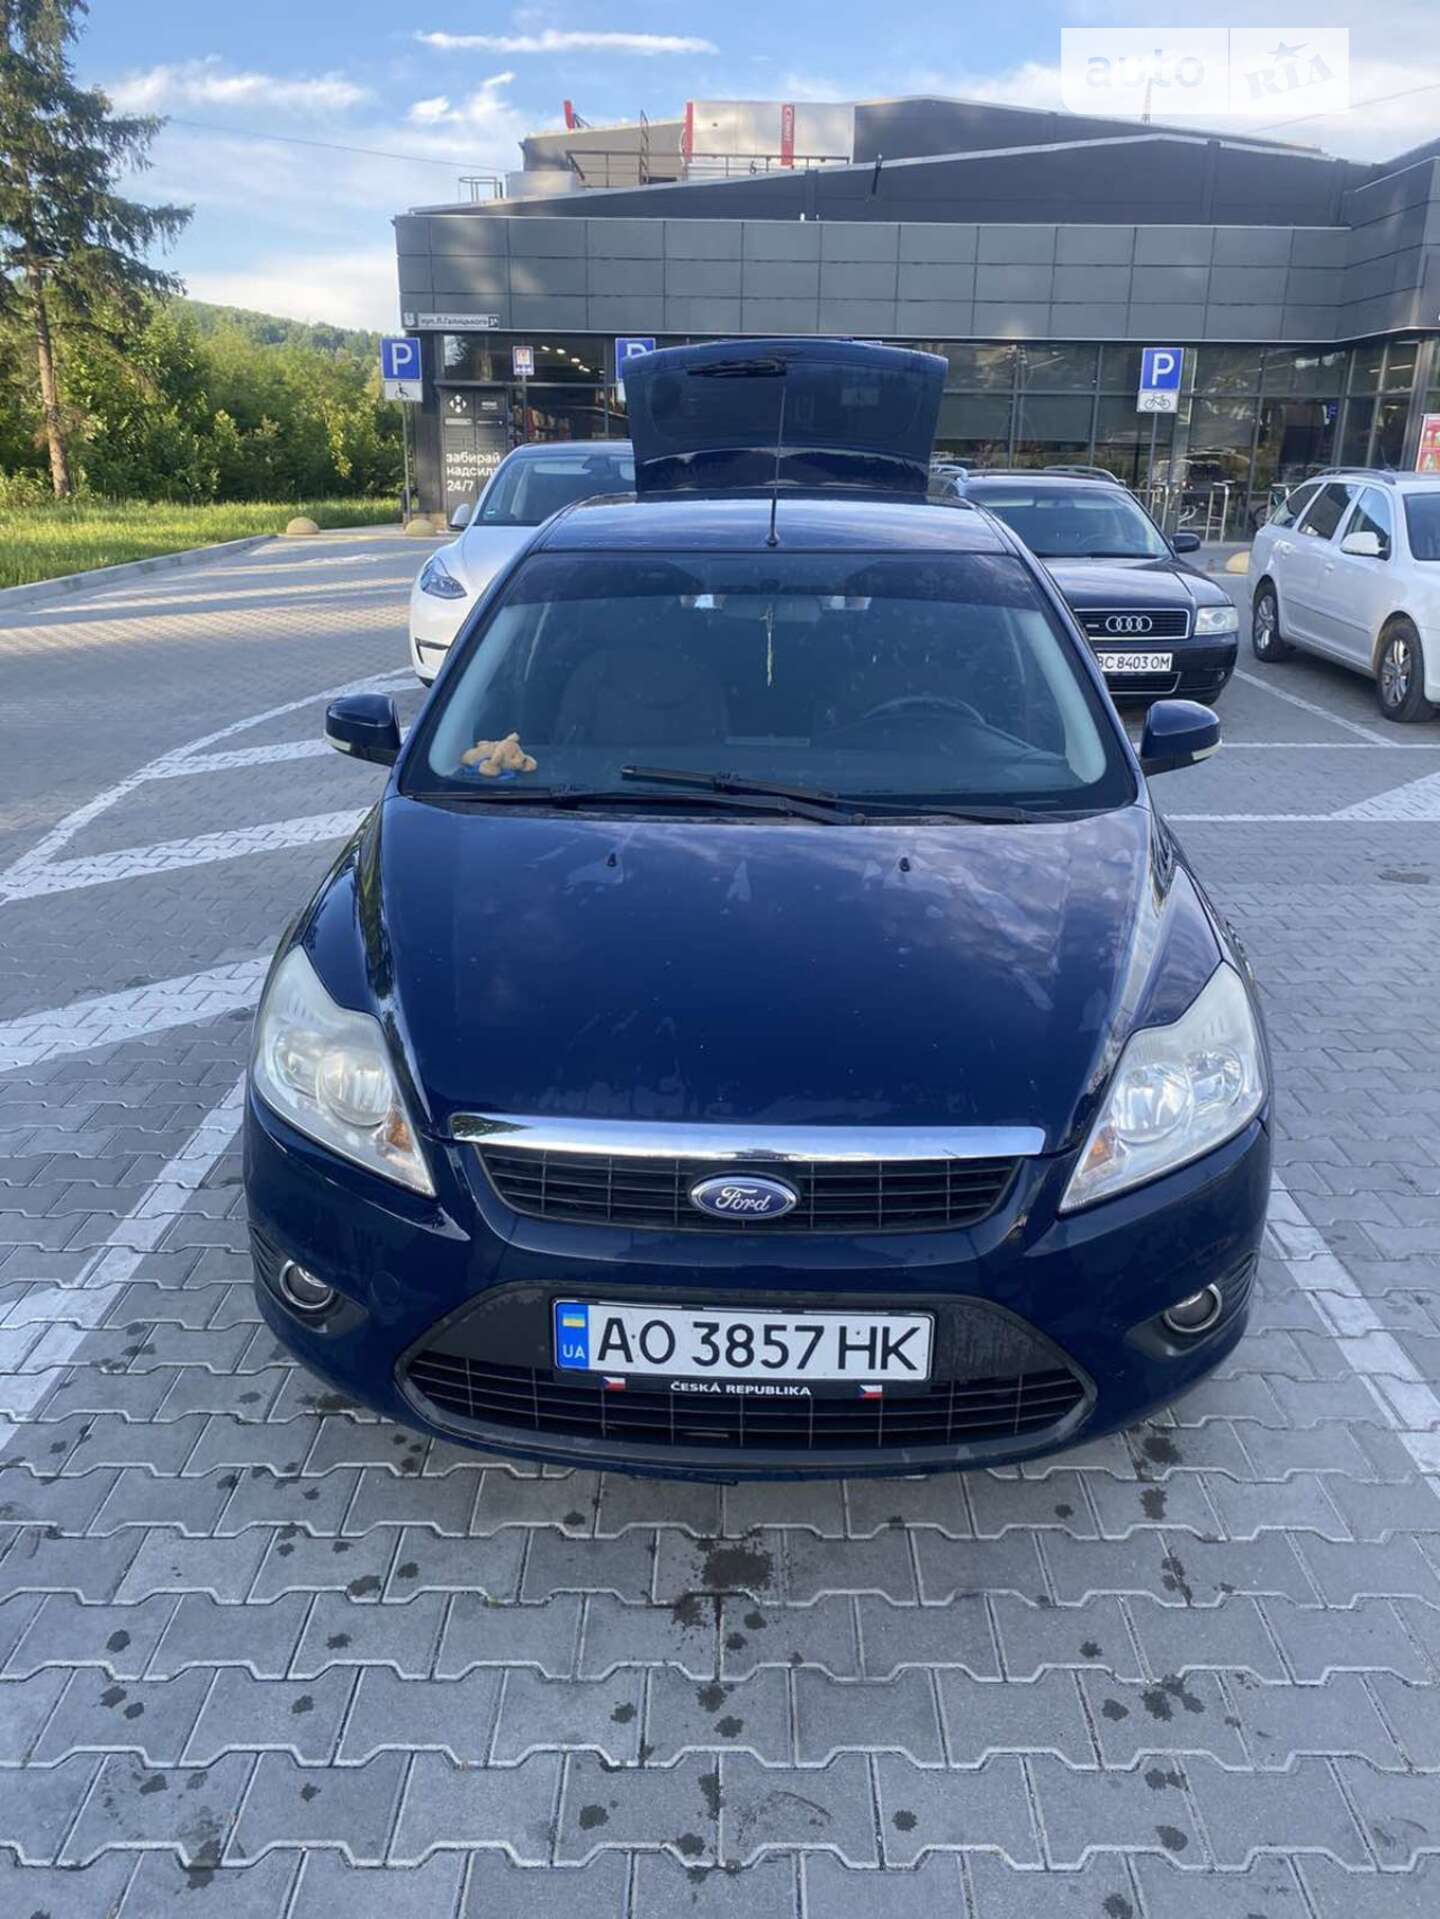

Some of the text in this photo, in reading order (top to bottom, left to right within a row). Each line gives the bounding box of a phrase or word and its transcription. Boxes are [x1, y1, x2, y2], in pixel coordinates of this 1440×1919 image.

[392, 343, 413, 375] P
[1152, 353, 1174, 386] P
[446, 451, 501, 466] забирай
[446, 466, 497, 477] надсил
[447, 480, 474, 492] 24/7
[1116, 656, 1149, 669] 8403
[1151, 656, 1170, 669] OM
[715, 1185, 770, 1212] Ford
[562, 1344, 586, 1360] UA
[597, 1317, 922, 1371] AO 3857 HK
[670, 1379, 811, 1397] ČESKÁ REPUBLIKA
